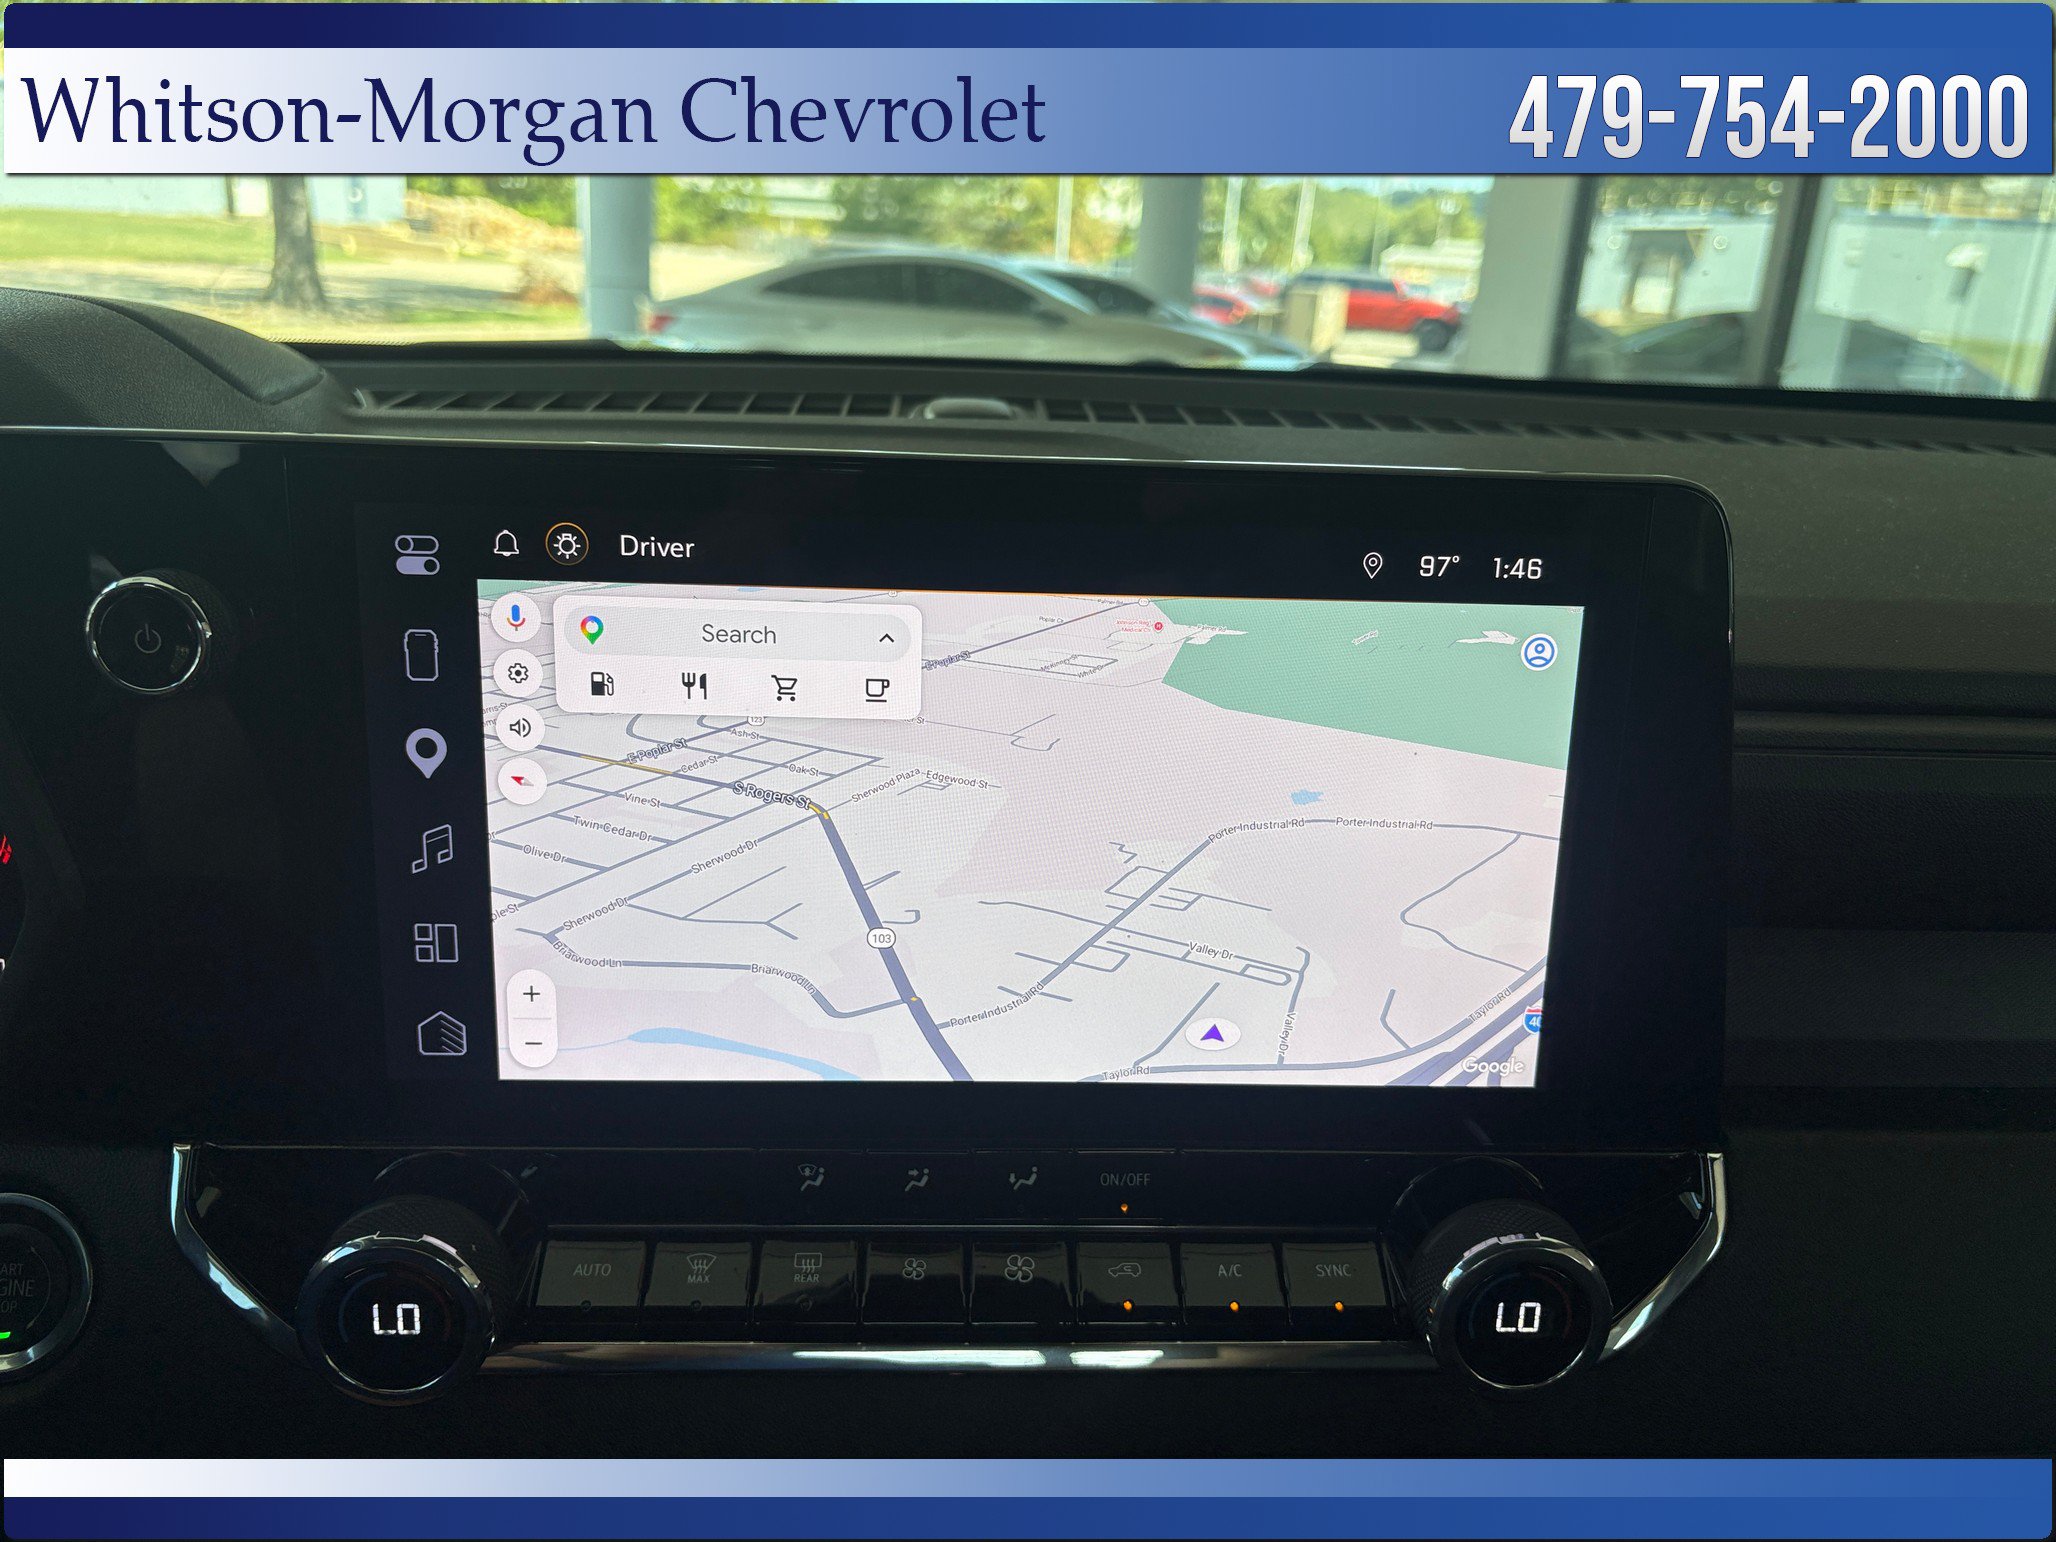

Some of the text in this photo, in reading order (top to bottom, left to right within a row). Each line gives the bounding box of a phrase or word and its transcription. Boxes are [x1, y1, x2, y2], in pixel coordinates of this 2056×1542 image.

[619, 533, 696, 559] Driver
[1418, 554, 1461, 578] 97°
[1492, 556, 1543, 580] 1:46
[701, 622, 778, 646] Search
[731, 728, 760, 741] Ash St
[638, 744, 672, 761] Poplar
[672, 737, 688, 750] St
[681, 754, 719, 774] Cedar St
[788, 763, 819, 777] Oak St
[851, 767, 921, 803] Sherwood Plaza
[925, 769, 989, 790] Edgewood St
[625, 792, 661, 808] Vine St
[732, 780, 812, 811] S Rogers St
[573, 815, 653, 842] Twin Cedar Dr
[1207, 817, 1305, 844] Porter Industrial Rd
[1335, 816, 1433, 830] Porter Industrial Rd
[523, 844, 566, 863] Olive Dr
[690, 839, 759, 875] Sherwood Dr
[507, 903, 519, 915] St
[562, 896, 629, 931] Sherwood Dr
[871, 933, 892, 945] 103
[552, 940, 622, 968] Briarwood Ln
[1189, 941, 1235, 961] Valley Dr
[751, 963, 816, 995] Briarwood Ln
[949, 981, 1045, 1028] Porter Industrial Rd
[1467, 987, 1512, 1023] Taylor Rd
[1278, 1011, 1297, 1057] Valley Dr
[1102, 1065, 1150, 1082] Taylor Rd
[1461, 1056, 1524, 1077] Google
[1099, 1172, 1151, 1187] ON/OFF
[572, 1262, 613, 1278] AUTO
[686, 1273, 711, 1284] MAX
[793, 1273, 820, 1283] REAR
[1217, 1264, 1243, 1278] A/C
[1315, 1263, 1353, 1278] SYNC
[372, 1303, 421, 1335] LO
[1494, 1301, 1542, 1334] LO
